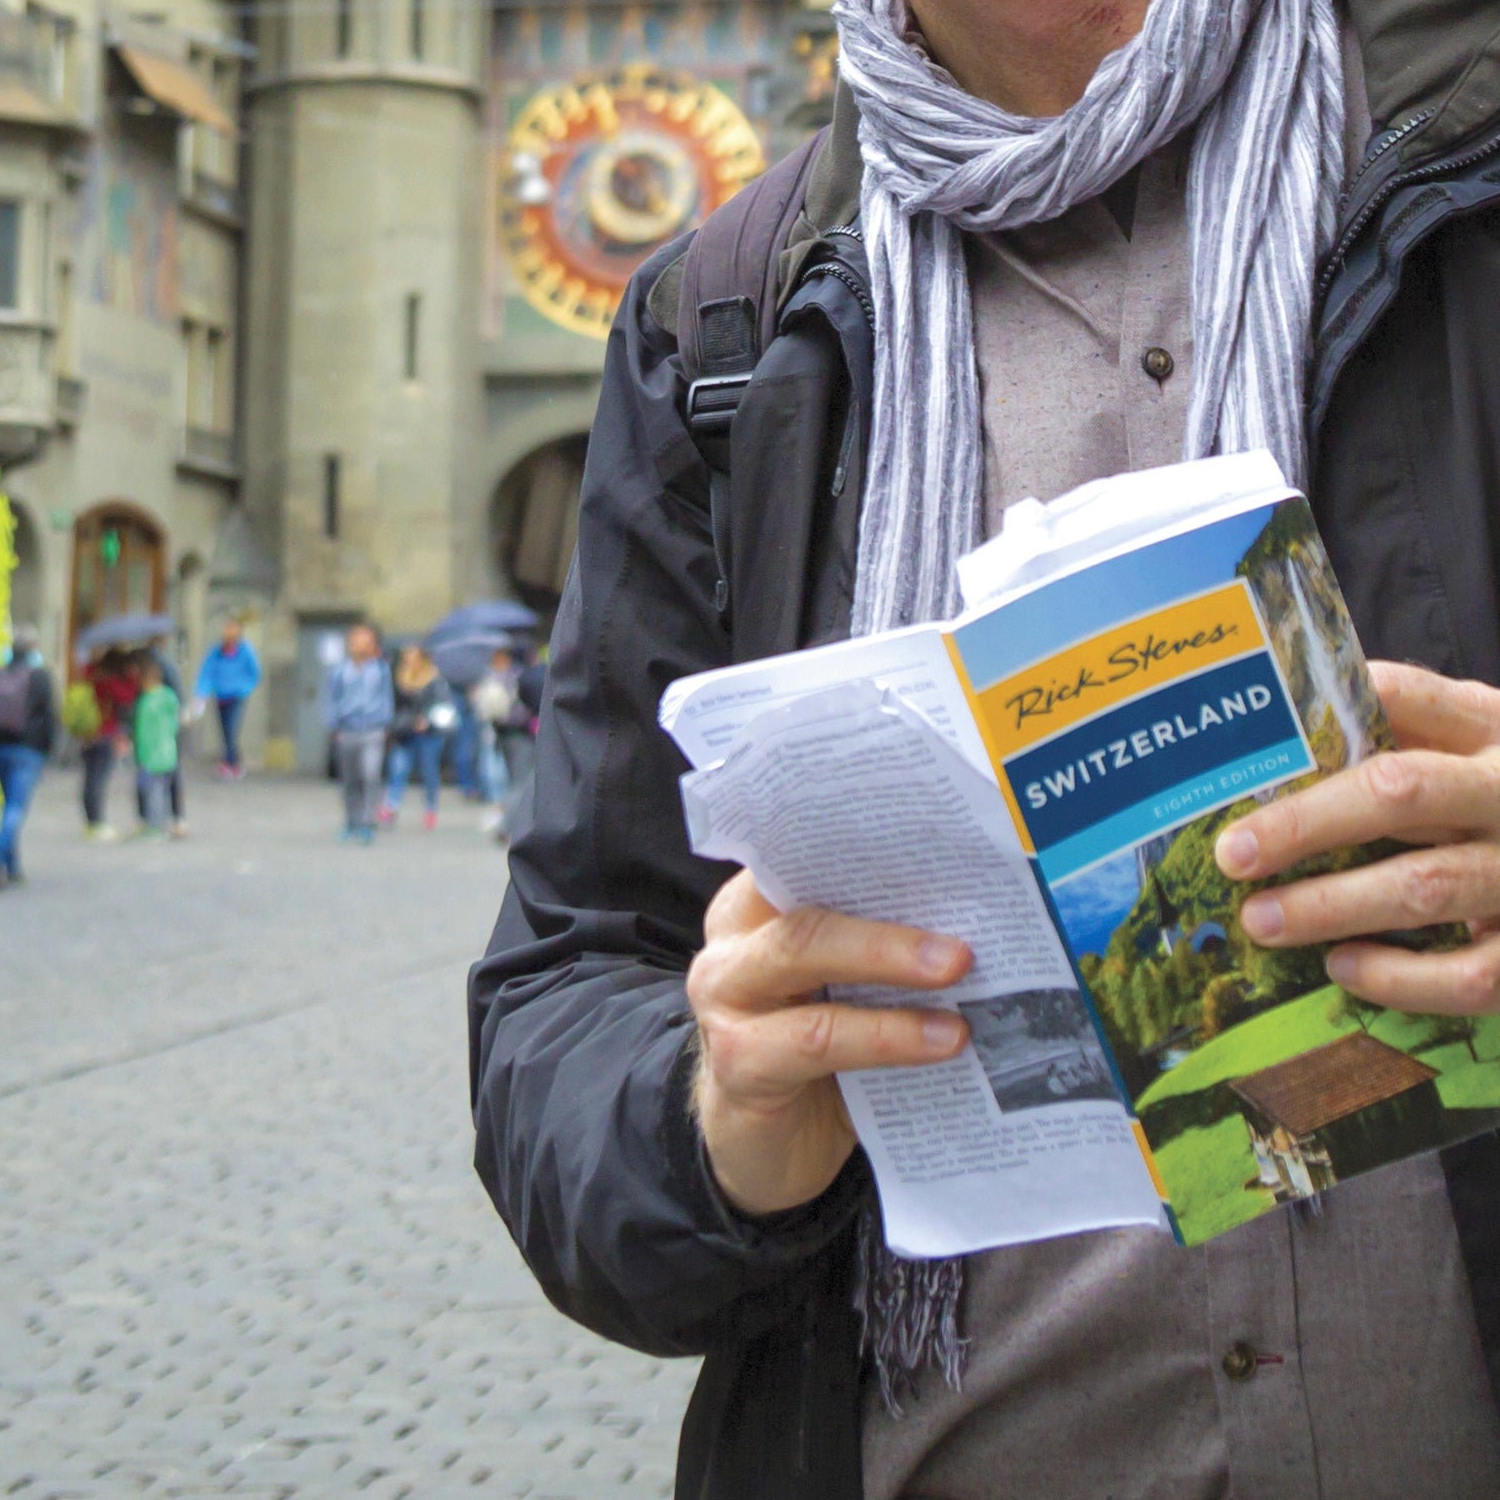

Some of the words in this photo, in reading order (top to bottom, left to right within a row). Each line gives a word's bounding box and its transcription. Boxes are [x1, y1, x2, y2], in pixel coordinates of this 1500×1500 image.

[1005, 668, 1105, 731] Rick
[1108, 623, 1239, 683] Steves
[1025, 684, 1272, 809] SWITZERLAND
[1153, 783, 1215, 819] EIGHTH
[1220, 752, 1291, 790] EDITION
